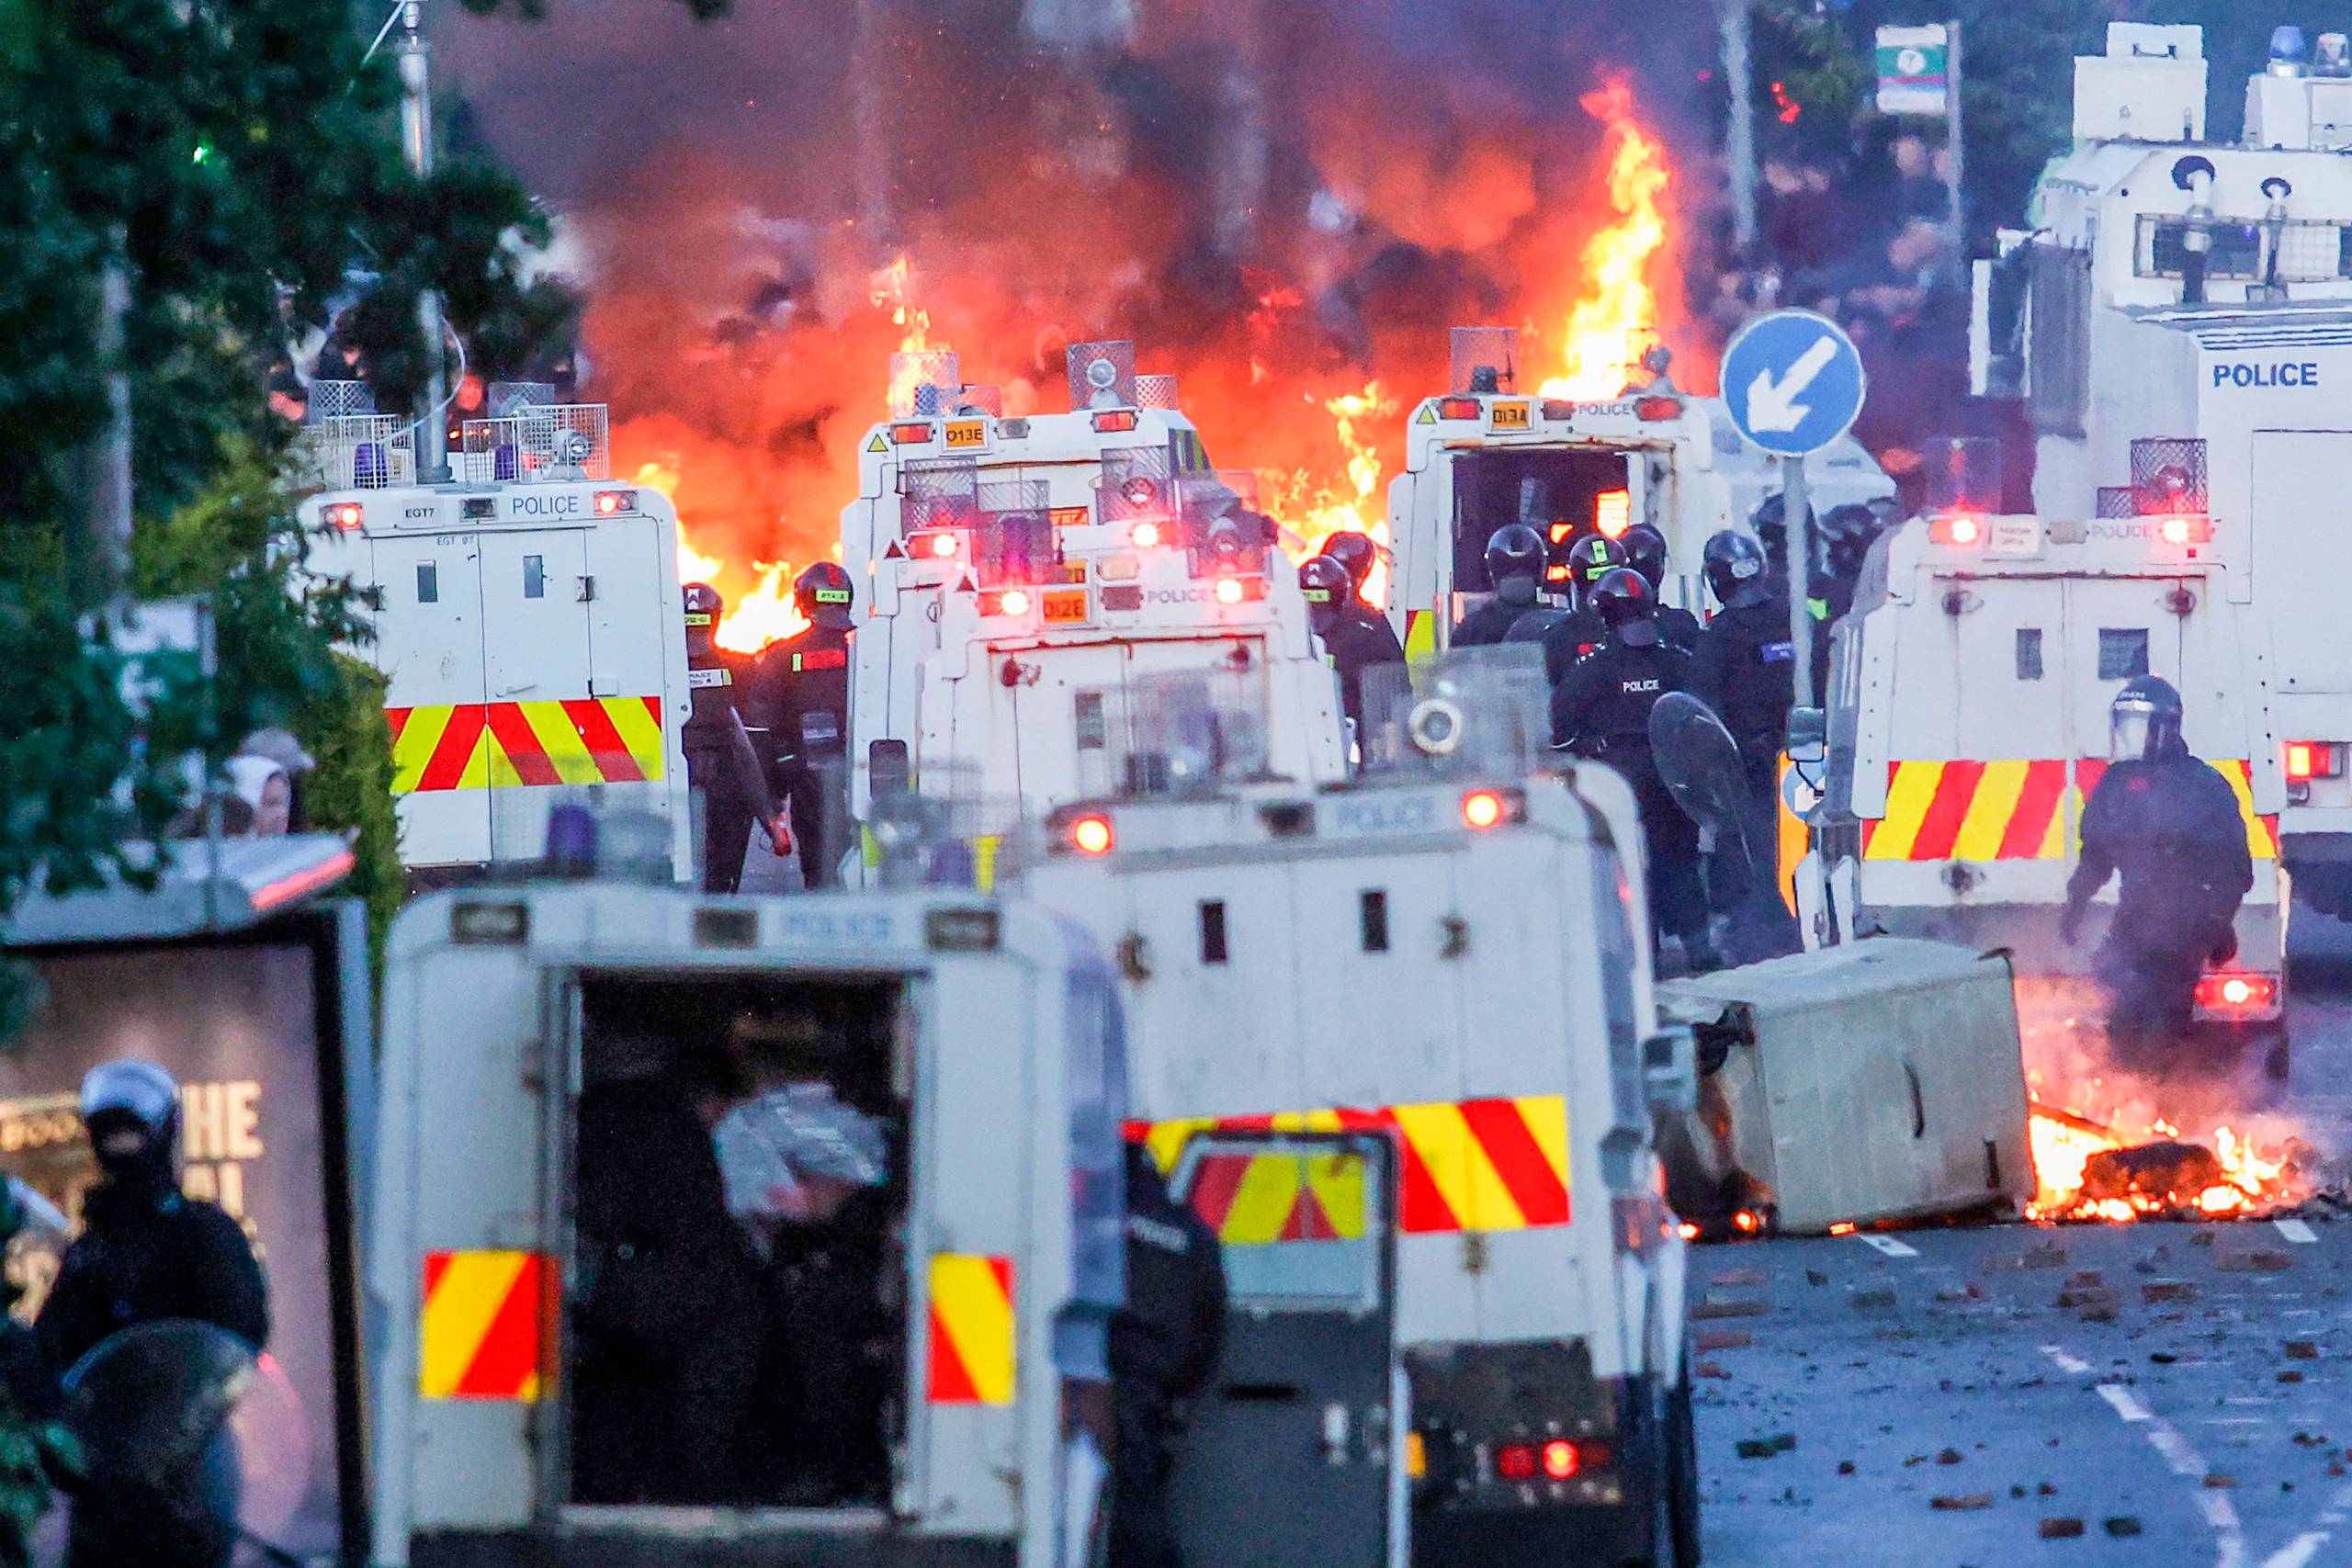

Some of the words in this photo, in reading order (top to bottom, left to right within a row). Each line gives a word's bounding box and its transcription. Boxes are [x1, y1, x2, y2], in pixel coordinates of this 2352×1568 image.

[2212, 362, 2318, 388] POLICE
[1578, 403, 1631, 415] POLICE
[513, 496, 578, 514] POLICE
[405, 507, 435, 518] EGT7
[2091, 524, 2154, 539] POLICE
[437, 536, 456, 546] EGT
[1622, 679, 1659, 693] POLICE
